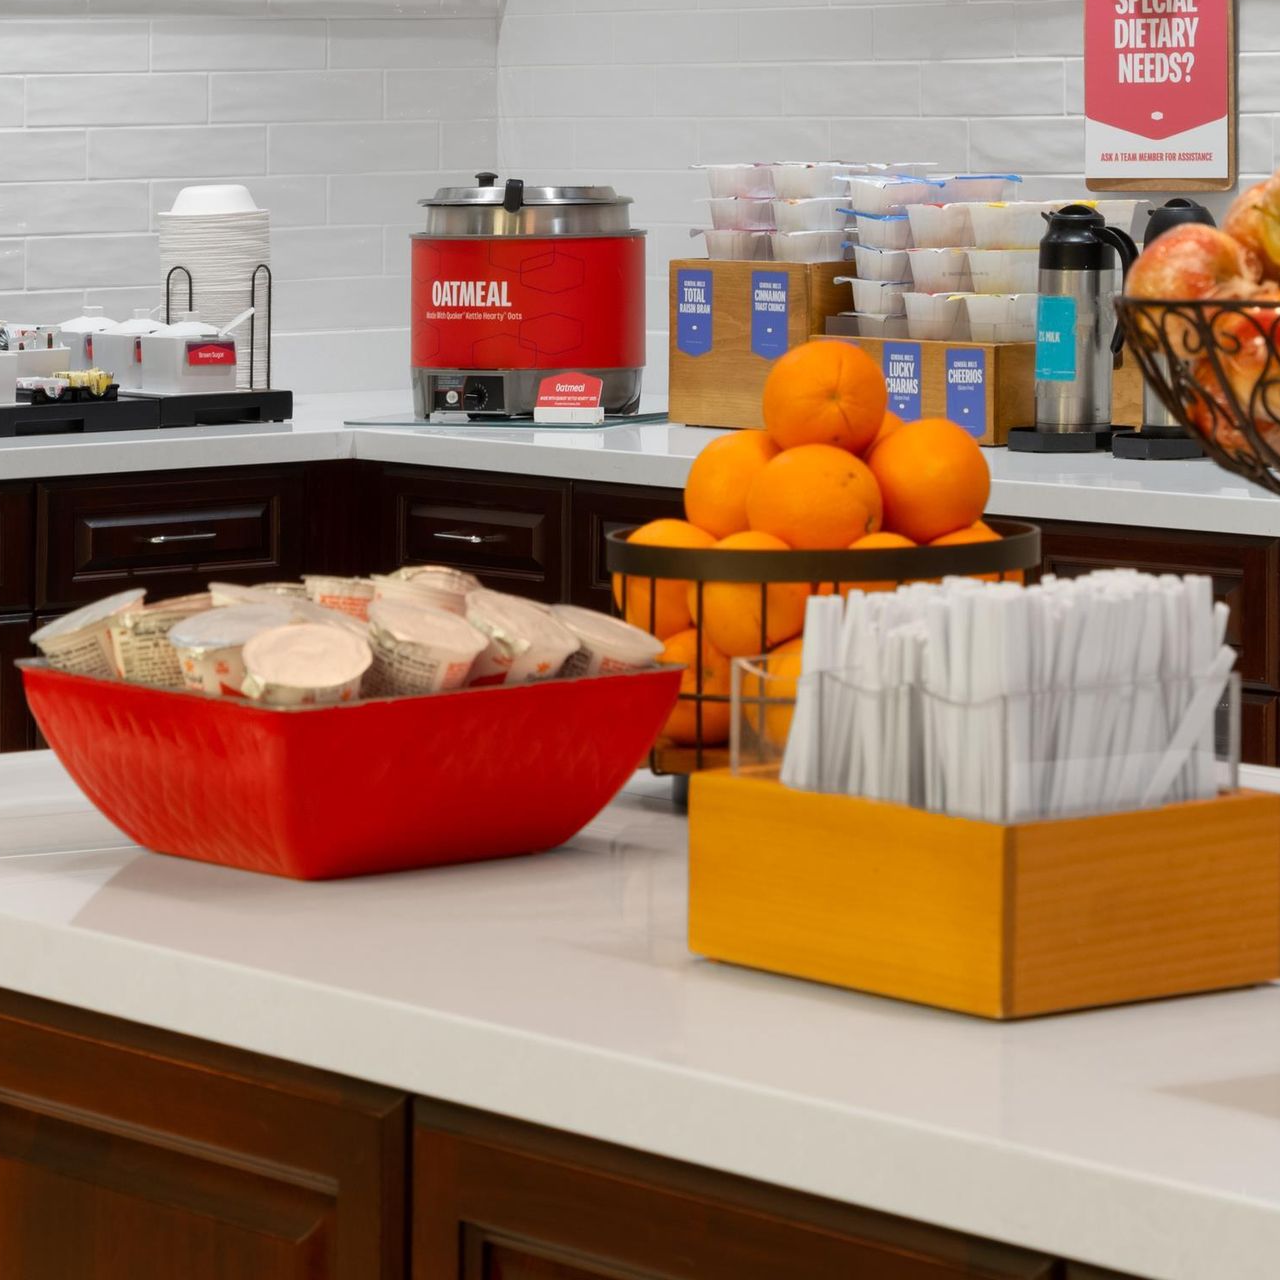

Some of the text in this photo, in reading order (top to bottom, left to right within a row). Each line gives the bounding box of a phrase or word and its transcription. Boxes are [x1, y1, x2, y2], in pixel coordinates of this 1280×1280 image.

[1114, 18, 1199, 49] DIETARY
[1119, 52, 1195, 84] NEEDS?
[1101, 151, 1213, 161] ASK A TEAM MEMBER FOR ASSISTANCE
[432, 280, 512, 307] OATMEAL
[683, 288, 706, 303] TOTAL
[754, 289, 786, 302] CINNAMON
[680, 303, 711, 314] RAISIN BRAN
[755, 302, 786, 312] TOAST CRUNCH
[466, 312, 482, 320] Kettle
[508, 312, 522, 320] Oats
[1045, 330, 1061, 344] MILK
[889, 361, 915, 378] LUCKY
[948, 369, 983, 384] CHEERIOS
[556, 383, 585, 393] Oatmeal
[885, 377, 919, 394] CHARMS
